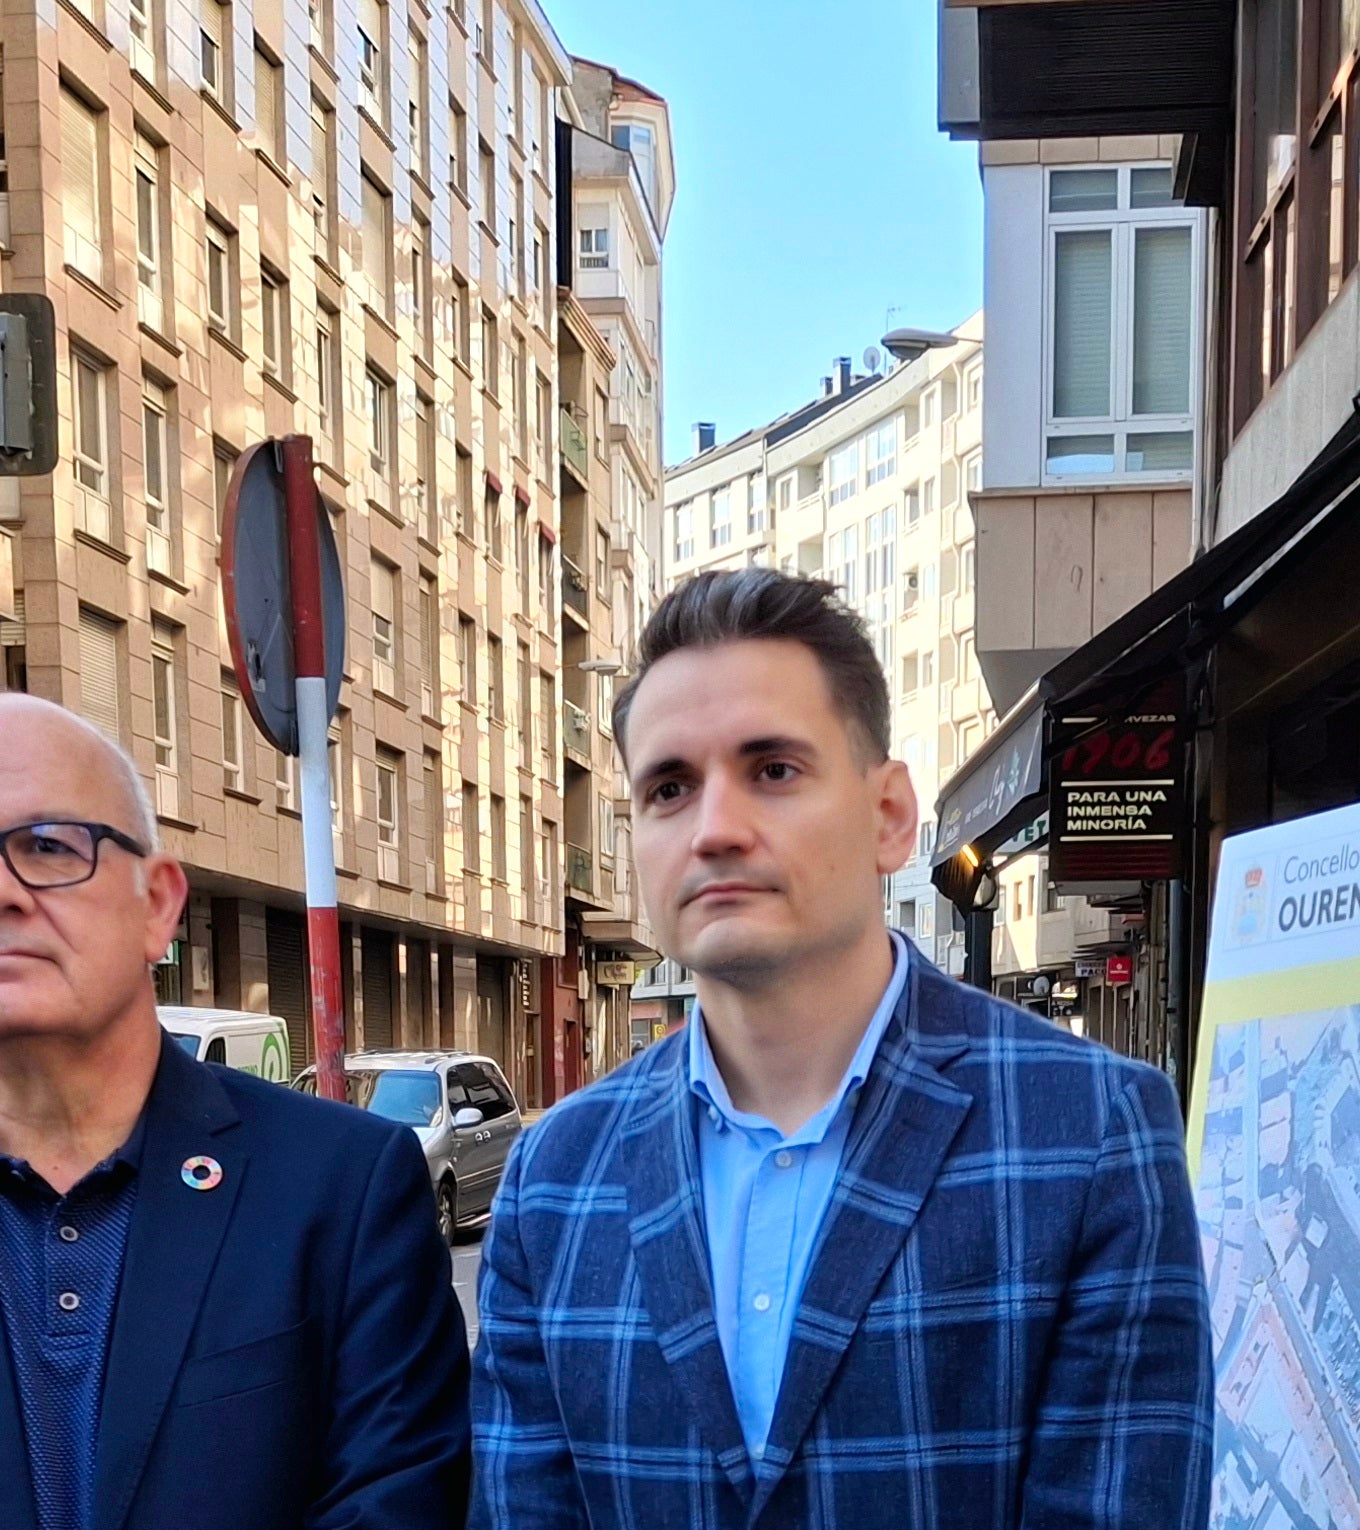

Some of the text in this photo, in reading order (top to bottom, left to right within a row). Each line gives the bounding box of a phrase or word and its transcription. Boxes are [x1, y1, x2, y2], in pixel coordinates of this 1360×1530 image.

[1062, 729, 1176, 774] 1906
[1067, 790, 1167, 803] PARA UNA
[1067, 805, 1152, 817] INMENSA
[1067, 816, 1147, 831] MINORÍA
[1284, 844, 1360, 884] Concello
